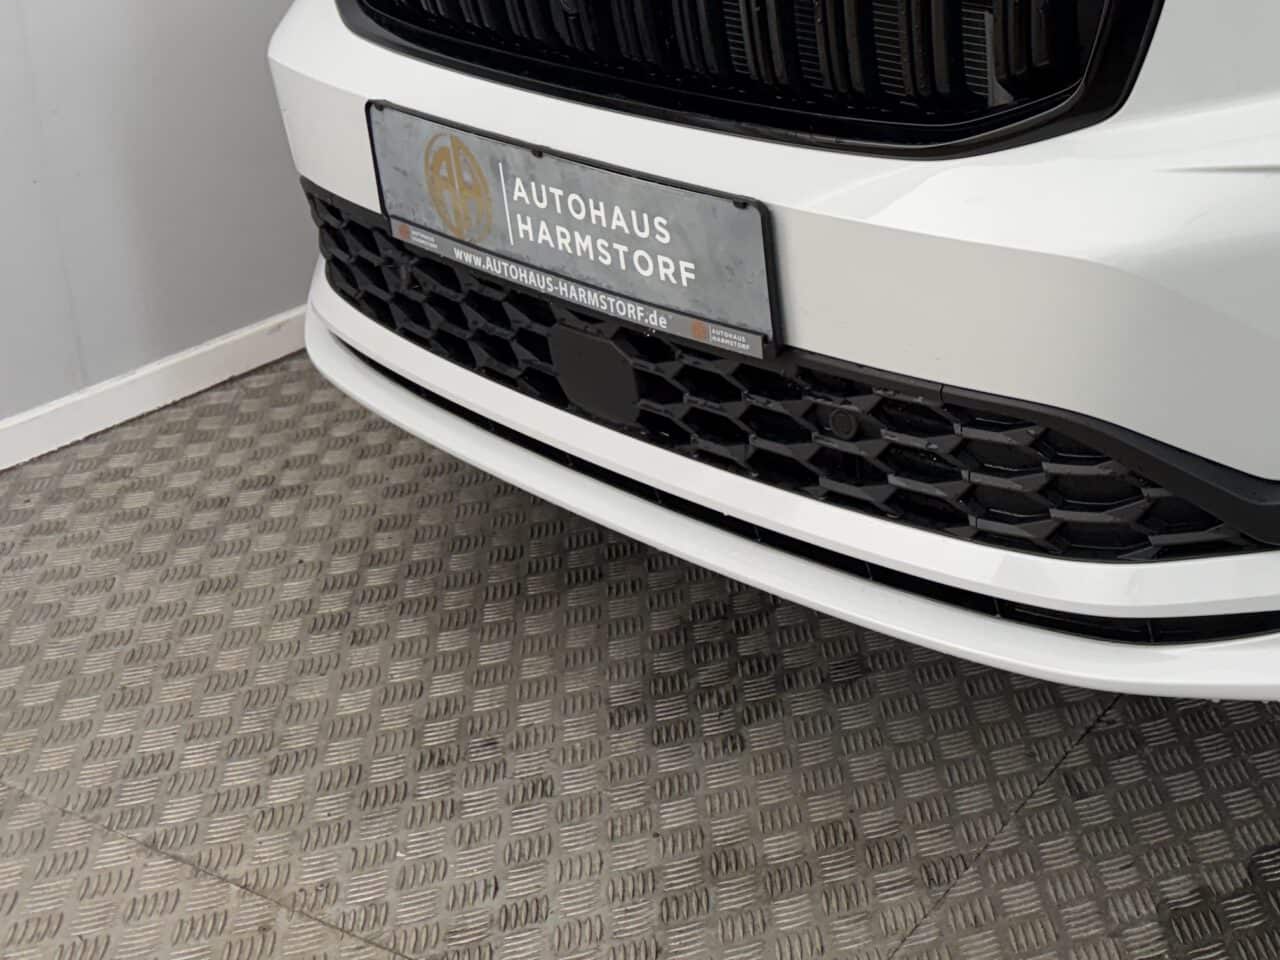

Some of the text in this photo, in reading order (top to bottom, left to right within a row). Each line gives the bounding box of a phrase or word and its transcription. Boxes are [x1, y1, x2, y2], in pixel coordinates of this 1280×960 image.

[513, 176, 671, 244] AUTOHAUS
[518, 213, 696, 287] HARMSTORF
[454, 247, 668, 329] www.AUTOHAUS-HARMSTORF.de
